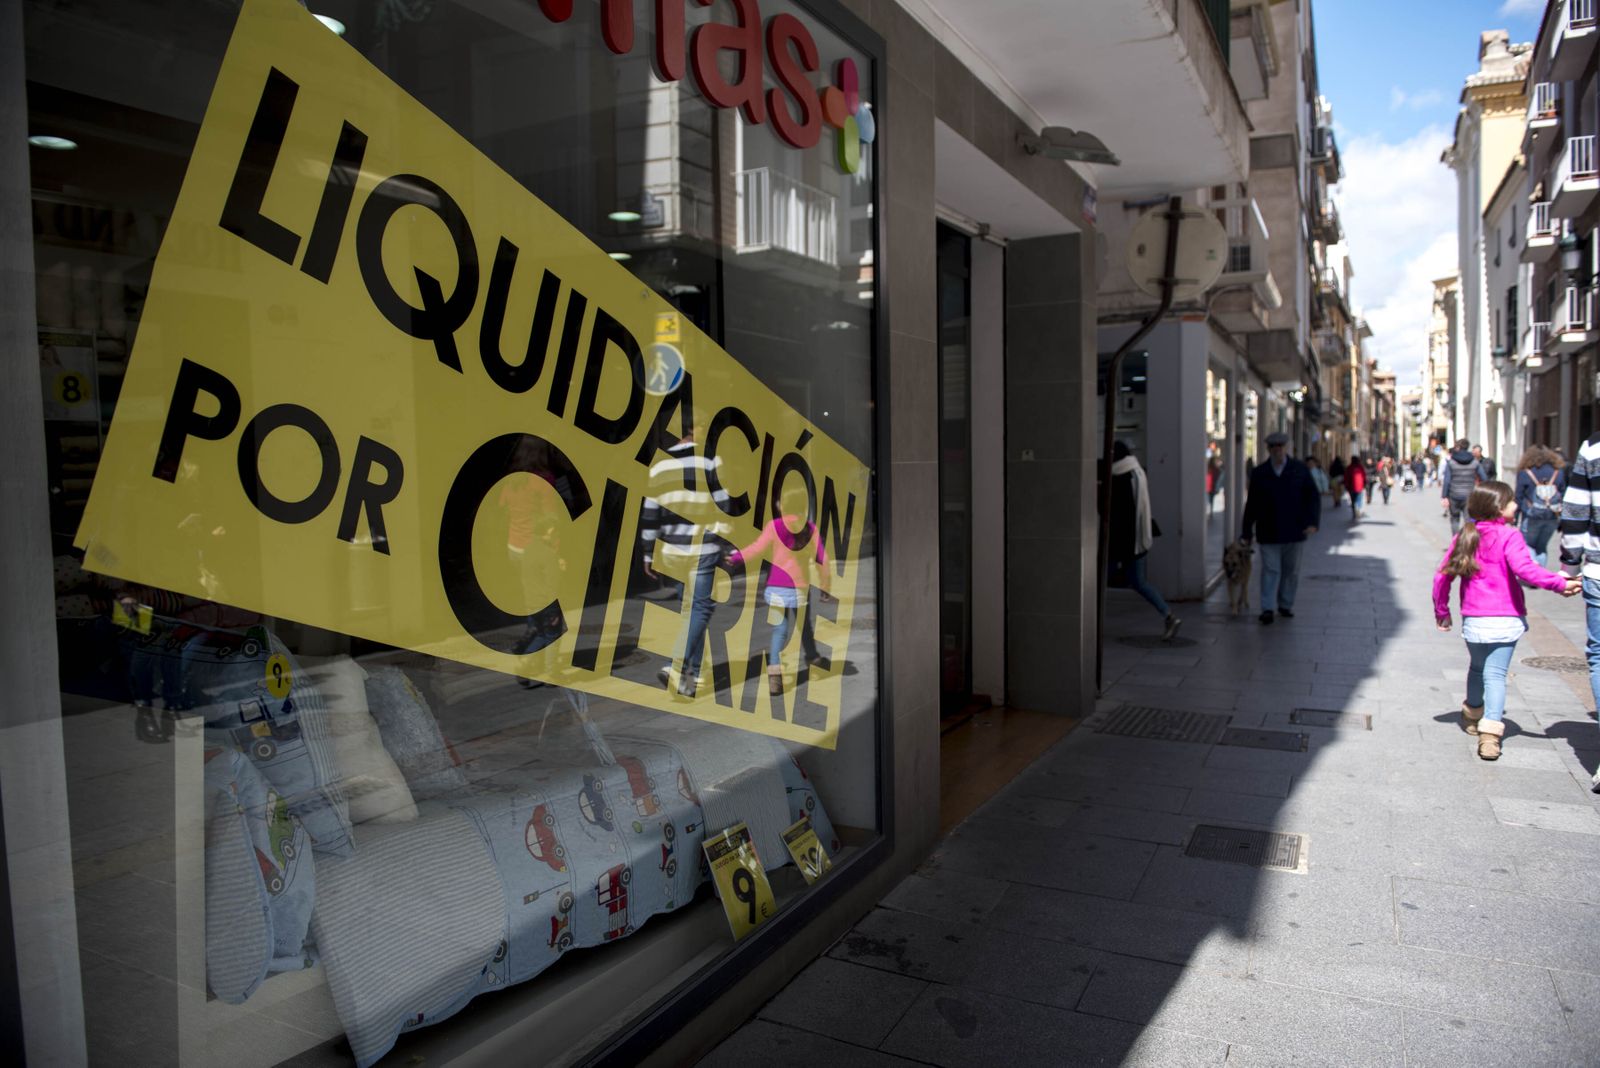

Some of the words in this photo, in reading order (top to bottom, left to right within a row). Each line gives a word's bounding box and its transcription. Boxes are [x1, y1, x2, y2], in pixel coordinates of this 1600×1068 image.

[219, 66, 856, 576] LIQUIDACIÓN
[63, 375, 81, 403] 8
[152, 357, 405, 556] POR
[438, 432, 839, 733] CIERRE
[273, 662, 282, 690] 9
[733, 867, 756, 925] 9
